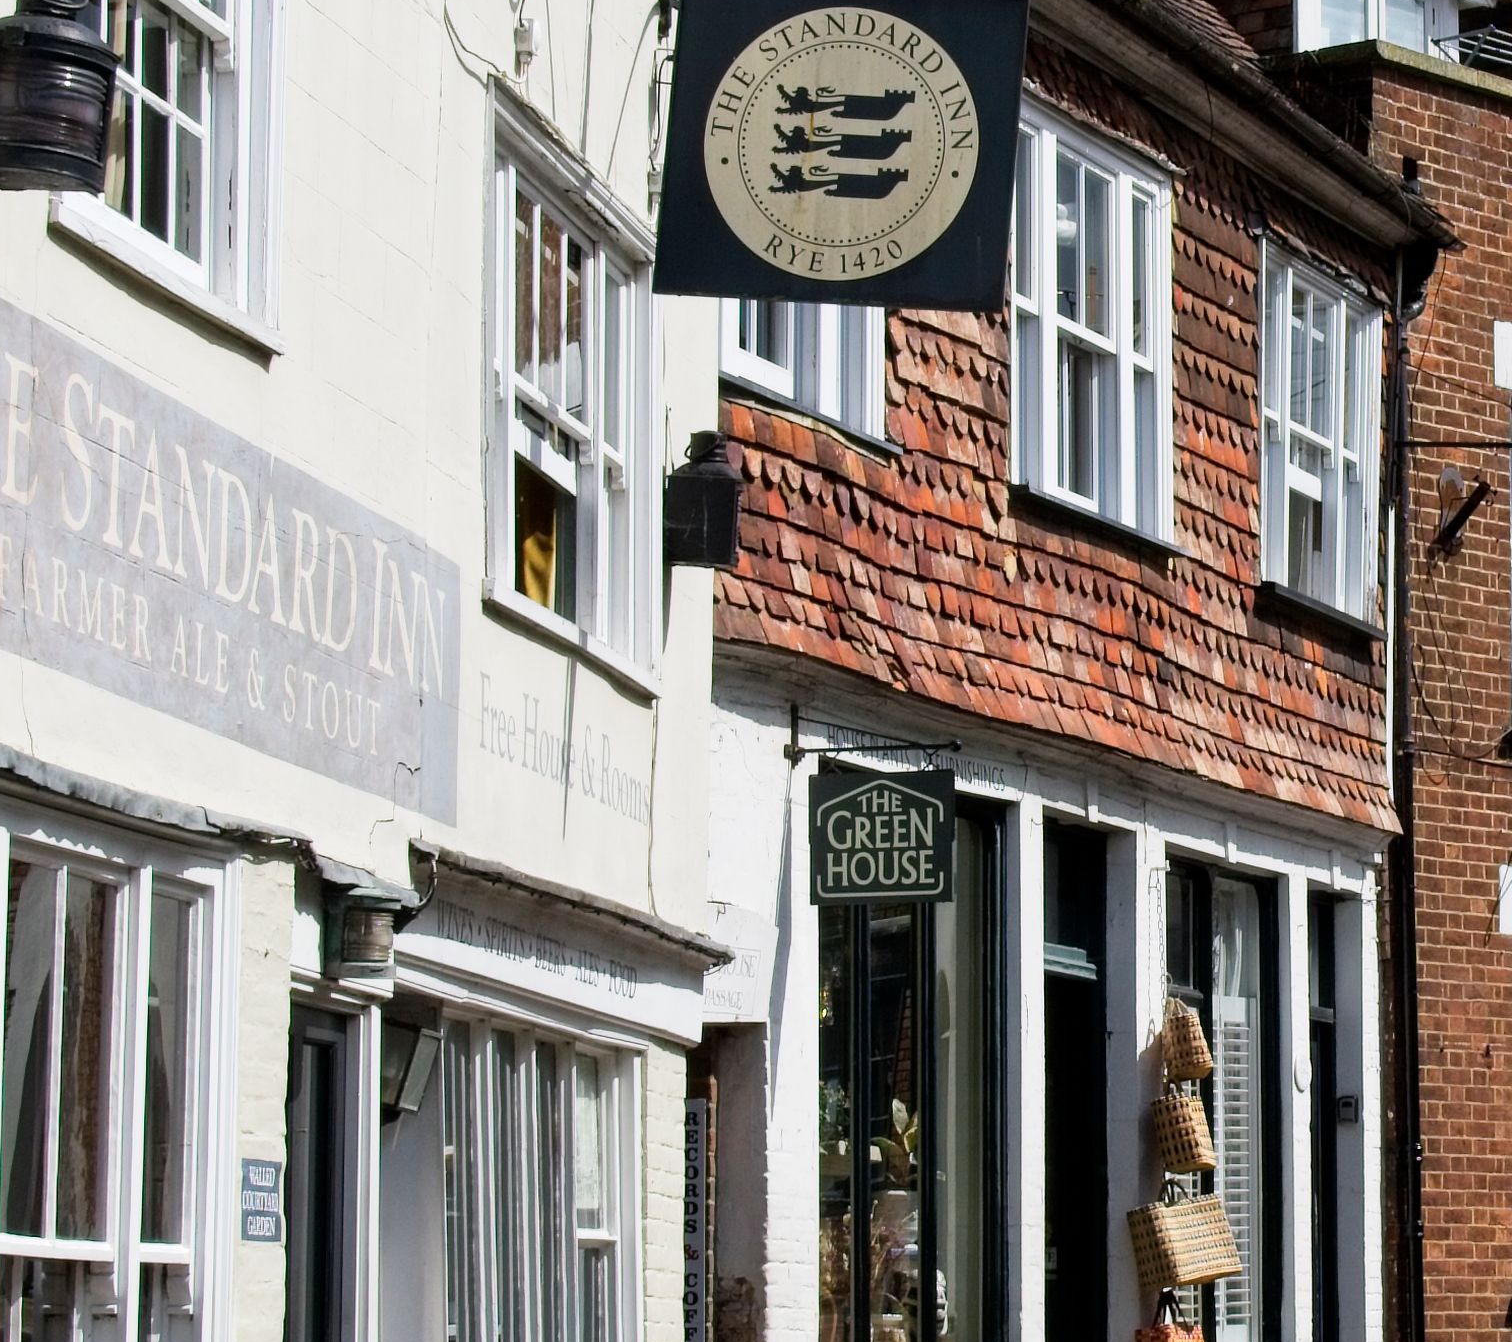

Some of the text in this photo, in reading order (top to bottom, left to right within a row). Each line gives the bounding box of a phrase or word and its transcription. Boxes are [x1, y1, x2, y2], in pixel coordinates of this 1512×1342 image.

[710, 12, 973, 151] THE STANDARD INN
[762, 232, 903, 274] RYE 1420
[60, 372, 358, 653] STANDARD
[368, 539, 446, 699] INN
[170, 613, 230, 694] ALE
[246, 647, 266, 711] &
[282, 662, 382, 756] STOUT
[479, 671, 650, 827] Free House & Rooms
[856, 789, 903, 814] THE
[827, 808, 934, 850] GREEN
[826, 849, 936, 887] HOUSE
[436, 898, 475, 946] WINES
[484, 916, 526, 964] SPIRITS
[534, 933, 567, 978] BEERS
[608, 958, 637, 1000] FOOD
[703, 987, 744, 1011] PASSAGE
[249, 1165, 276, 1187] WALLED
[684, 1111, 700, 1235] RECORDS
[242, 1189, 279, 1213] COURTYARD
[247, 1216, 277, 1237] GARDEN
[684, 1242, 700, 1261] &
